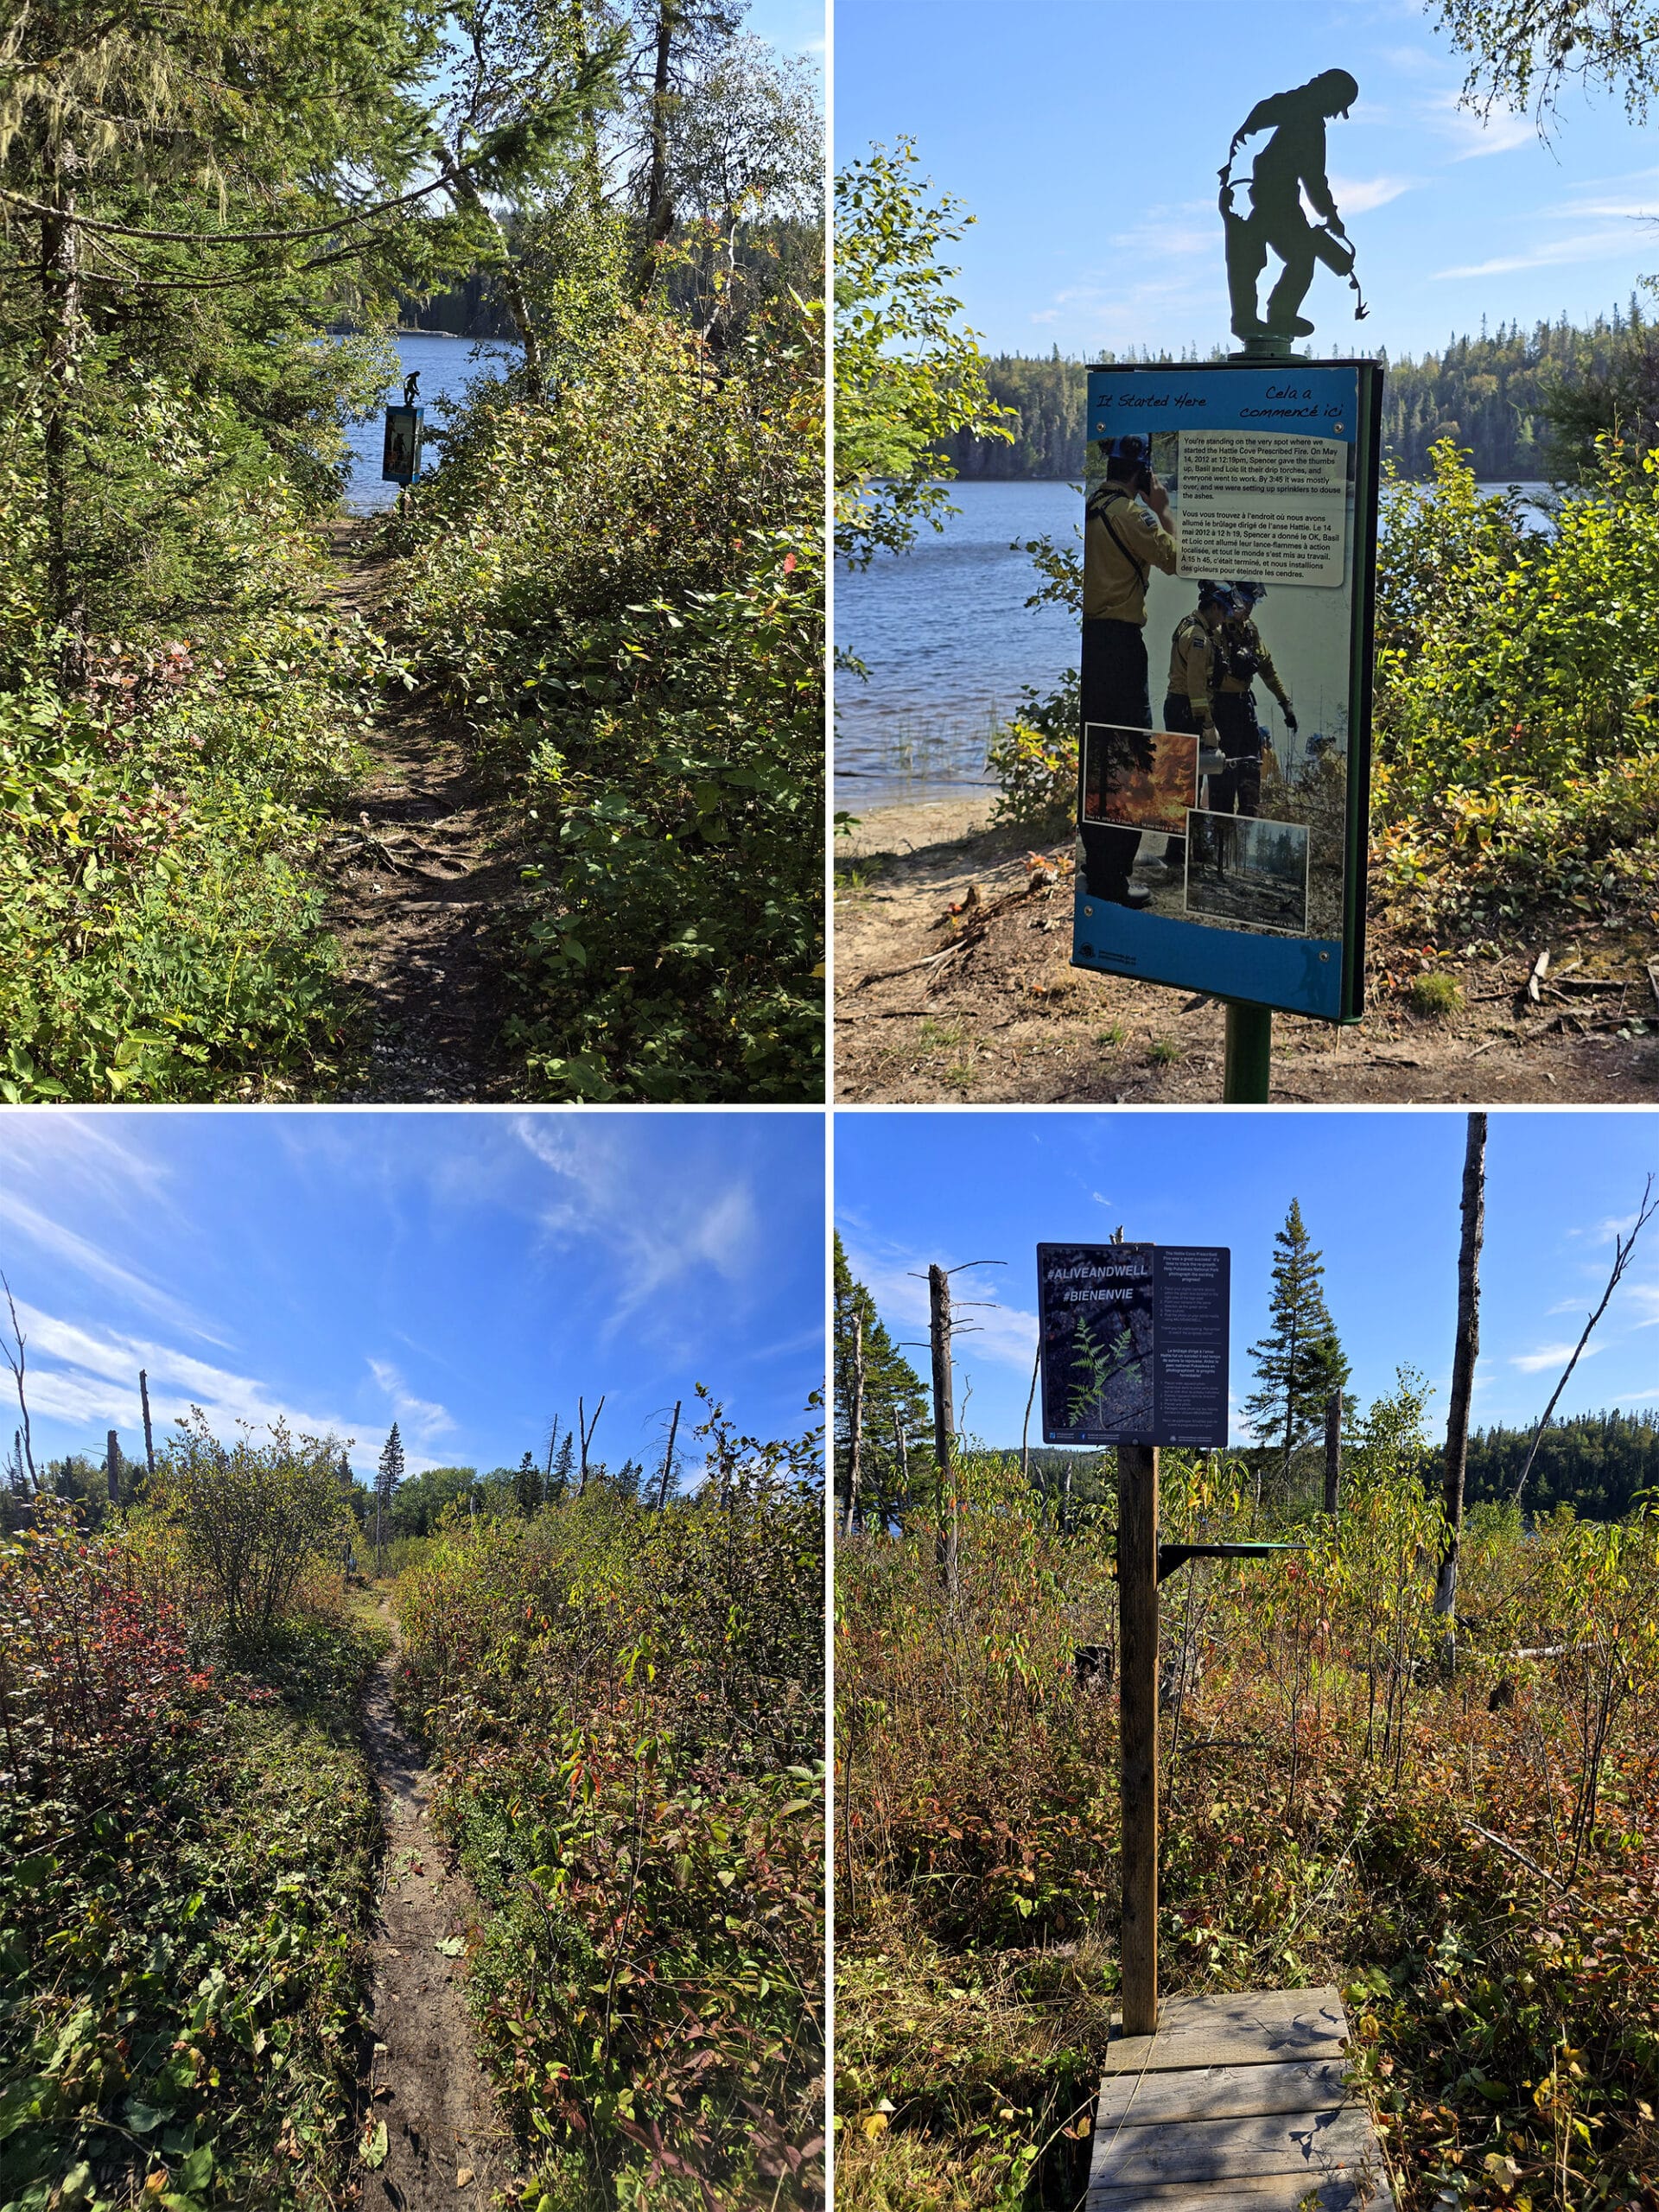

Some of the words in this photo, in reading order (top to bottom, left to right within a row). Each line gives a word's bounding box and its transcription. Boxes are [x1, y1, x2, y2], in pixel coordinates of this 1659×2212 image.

[1266, 385, 1297, 400] Cela
[1302, 390, 1312, 400] a
[1096, 396, 1113, 407] It
[1118, 394, 1168, 407] Started
[1174, 393, 1206, 407] Here
[1239, 404, 1319, 418] commencé
[1324, 407, 1344, 417] ici
[1274, 438, 1288, 447] spot
[1323, 448, 1338, 456] May
[1243, 485, 1264, 493] setting
[1277, 486, 1309, 494] sprinklers
[1212, 520, 1236, 530] brûlage
[1238, 521, 1257, 530] dirigé
[1243, 531, 1270, 540] Spencer
[1193, 566, 1218, 575] gicleurs
[1047, 1264, 1147, 1280] #ALIVEANDWELL
[1063, 1288, 1133, 1301] #BIENENVIE
